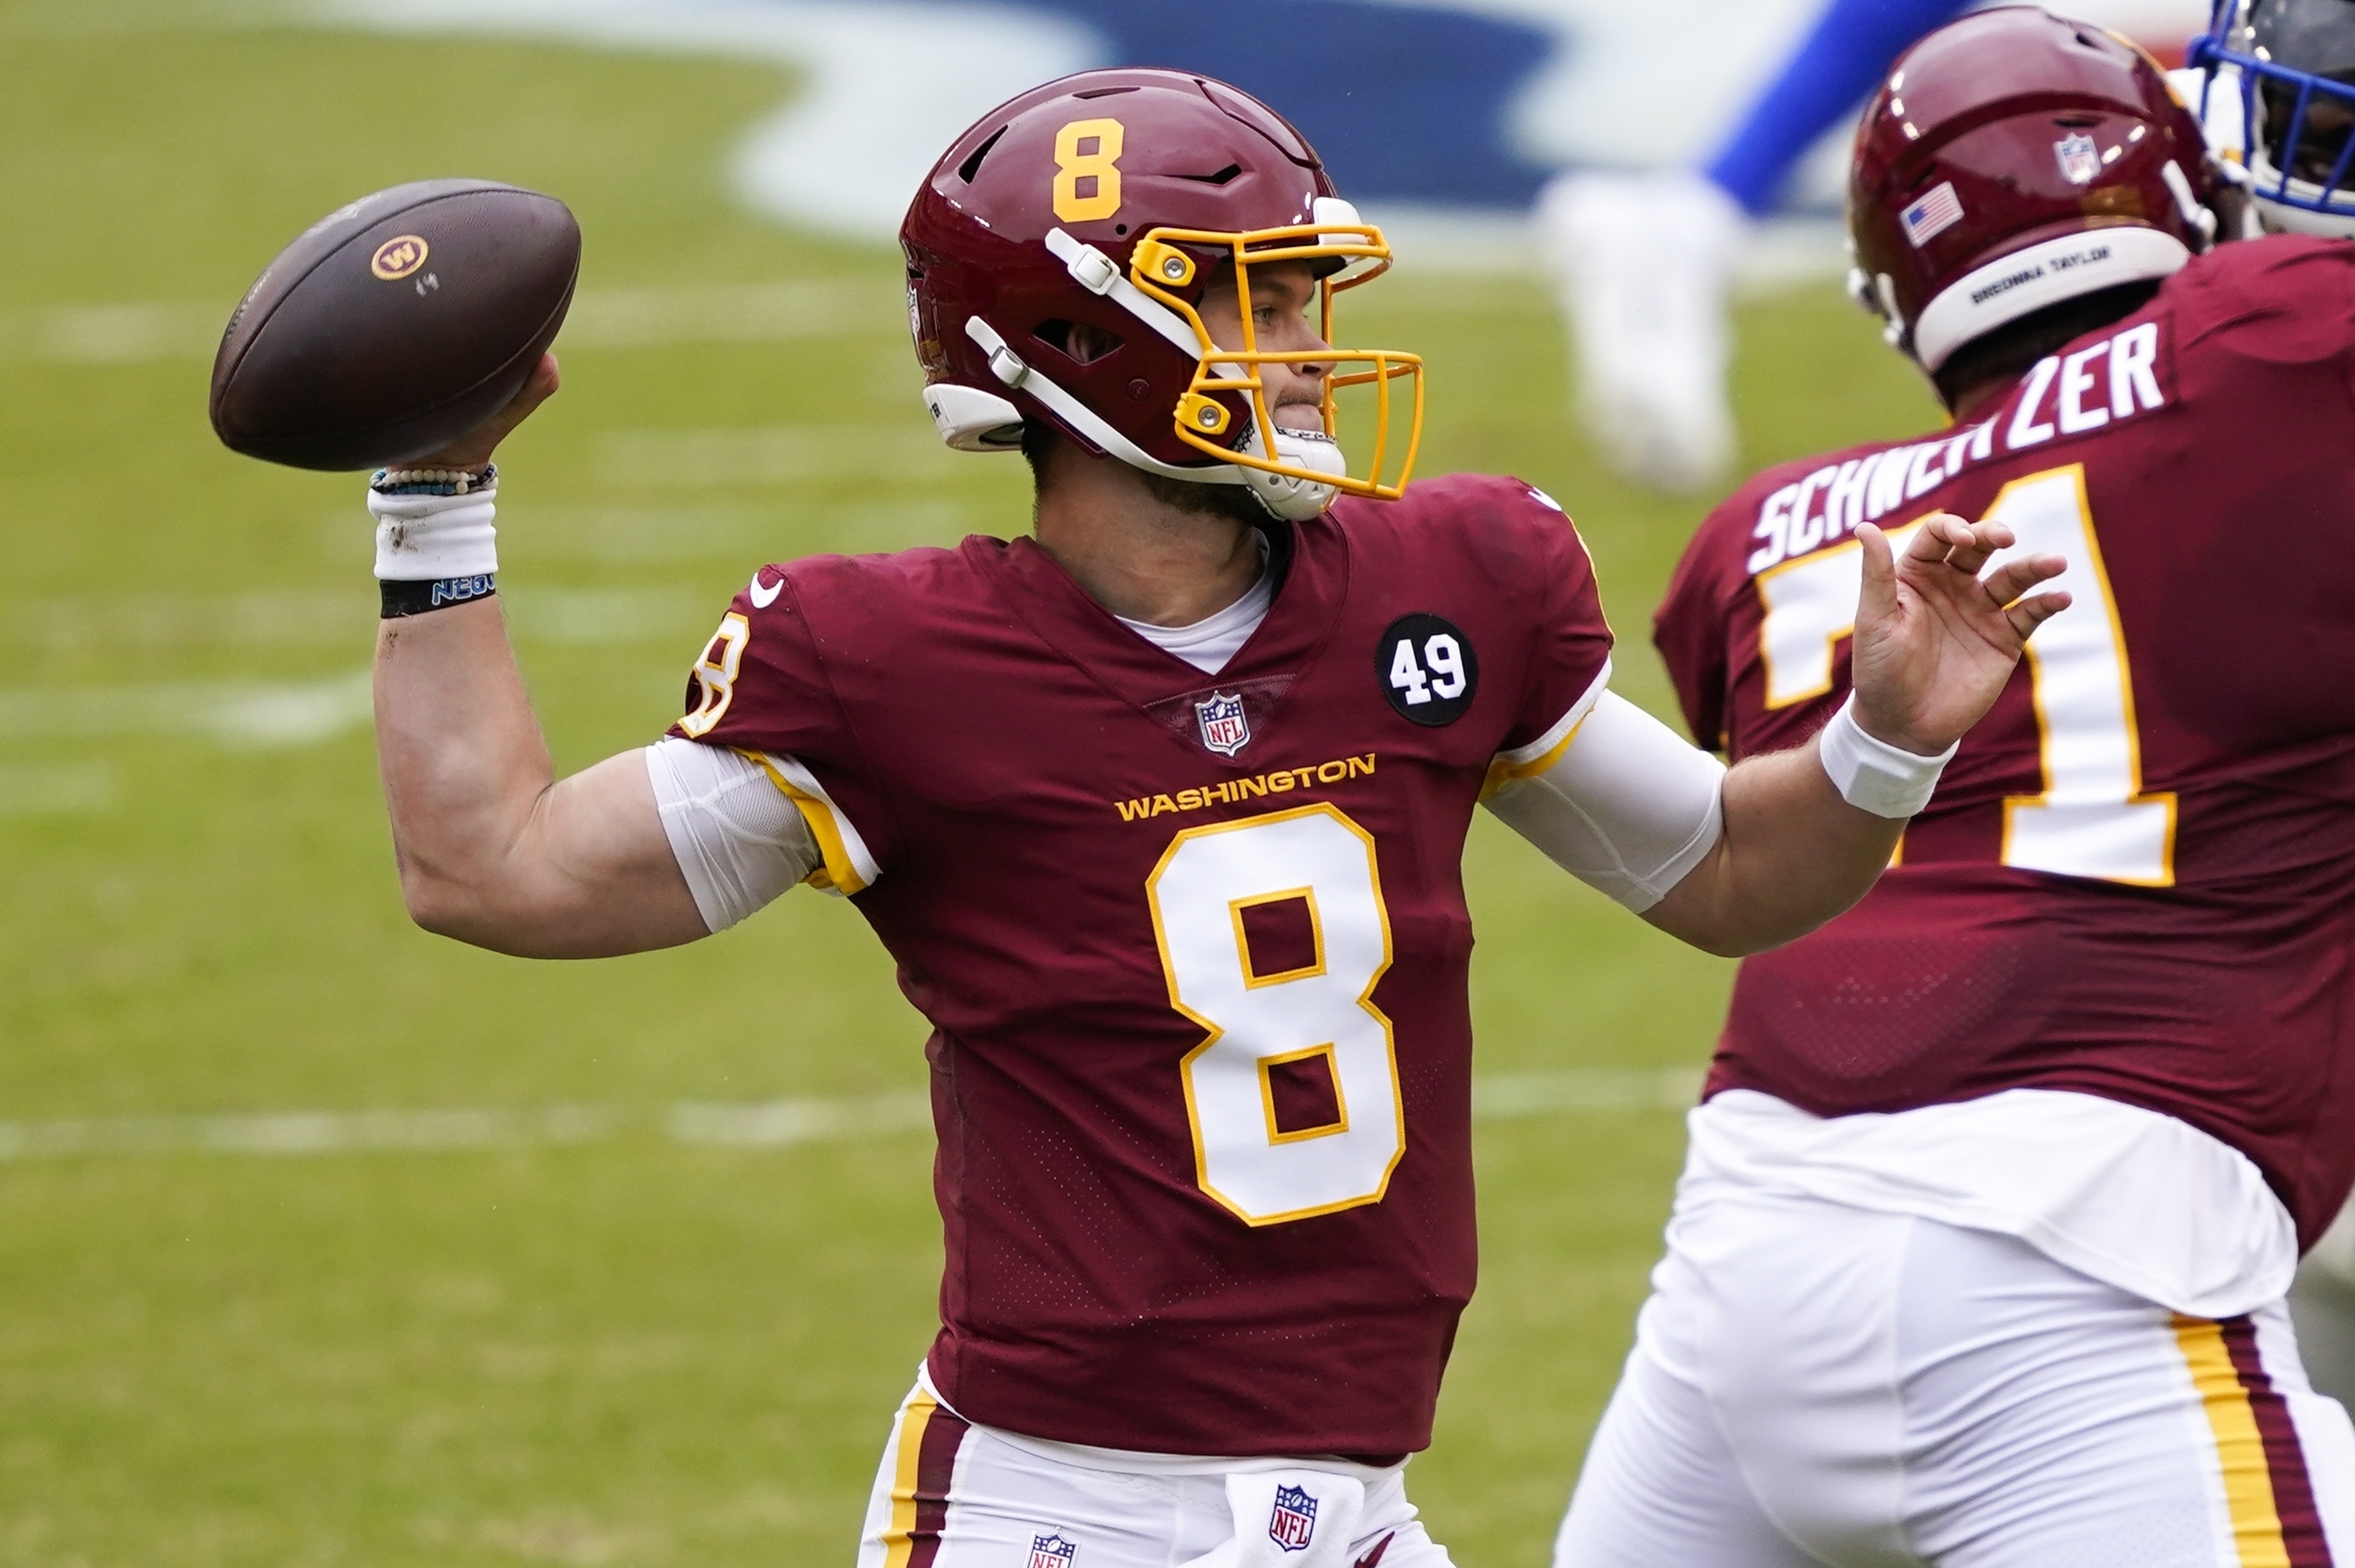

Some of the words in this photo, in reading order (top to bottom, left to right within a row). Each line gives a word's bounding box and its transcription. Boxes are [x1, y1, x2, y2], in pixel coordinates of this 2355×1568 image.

[1052, 118, 1125, 223] 8
[677, 610, 751, 739] 8
[1389, 633, 1466, 705] 49
[1208, 718, 1243, 744] NFL
[1114, 753, 1377, 822] WASHINGTON
[1144, 801, 1406, 1228] 8
[1272, 1509, 1308, 1545] NFL
